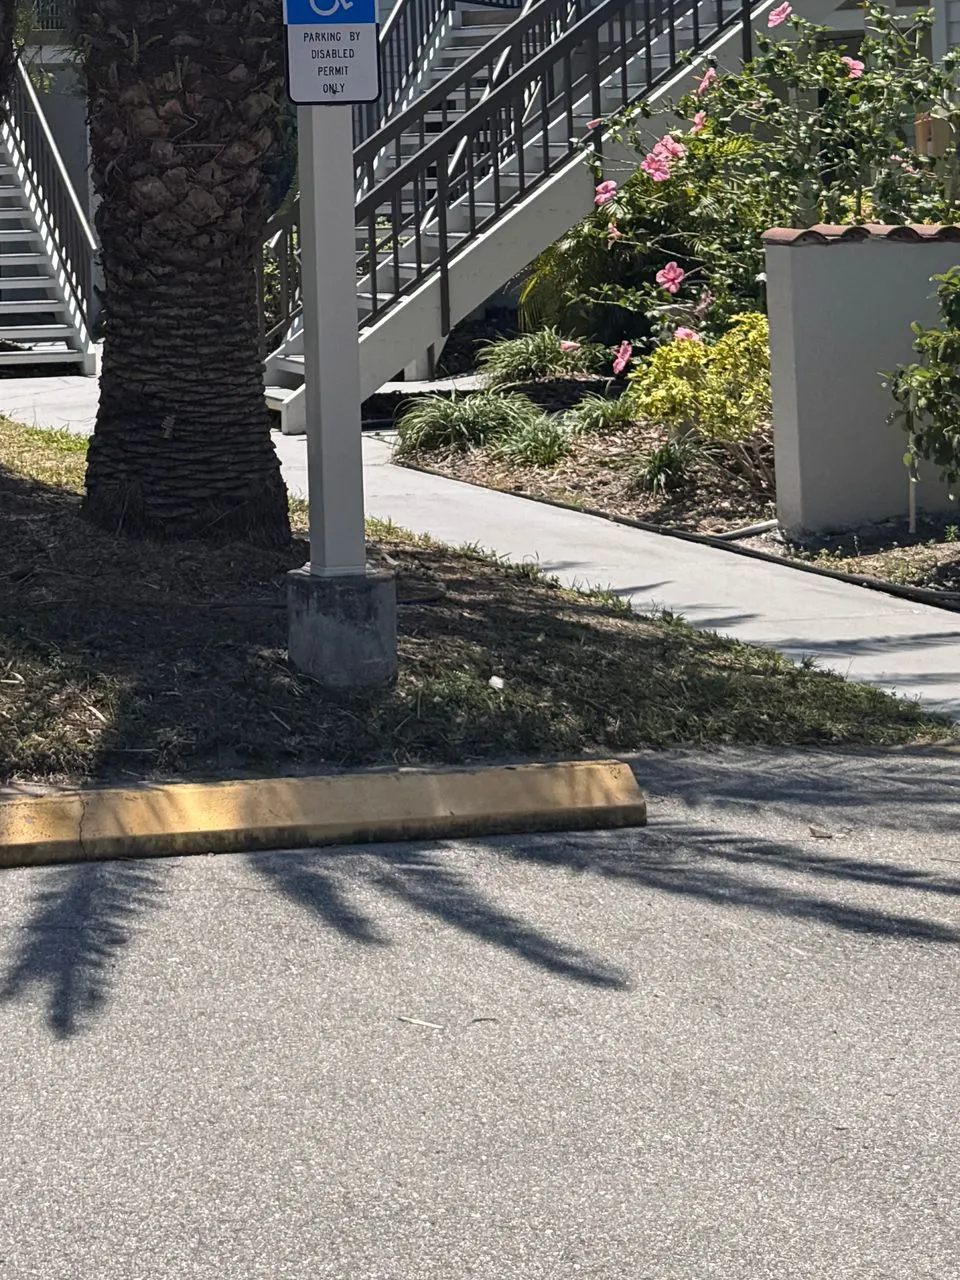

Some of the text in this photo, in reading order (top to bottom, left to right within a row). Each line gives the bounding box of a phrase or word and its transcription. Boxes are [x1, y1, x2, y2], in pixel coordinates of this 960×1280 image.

[303, 31, 361, 42] PARKING BY
[311, 49, 355, 59] DISABLED
[317, 66, 349, 76] PERMIT
[322, 83, 345, 94] ONLY
